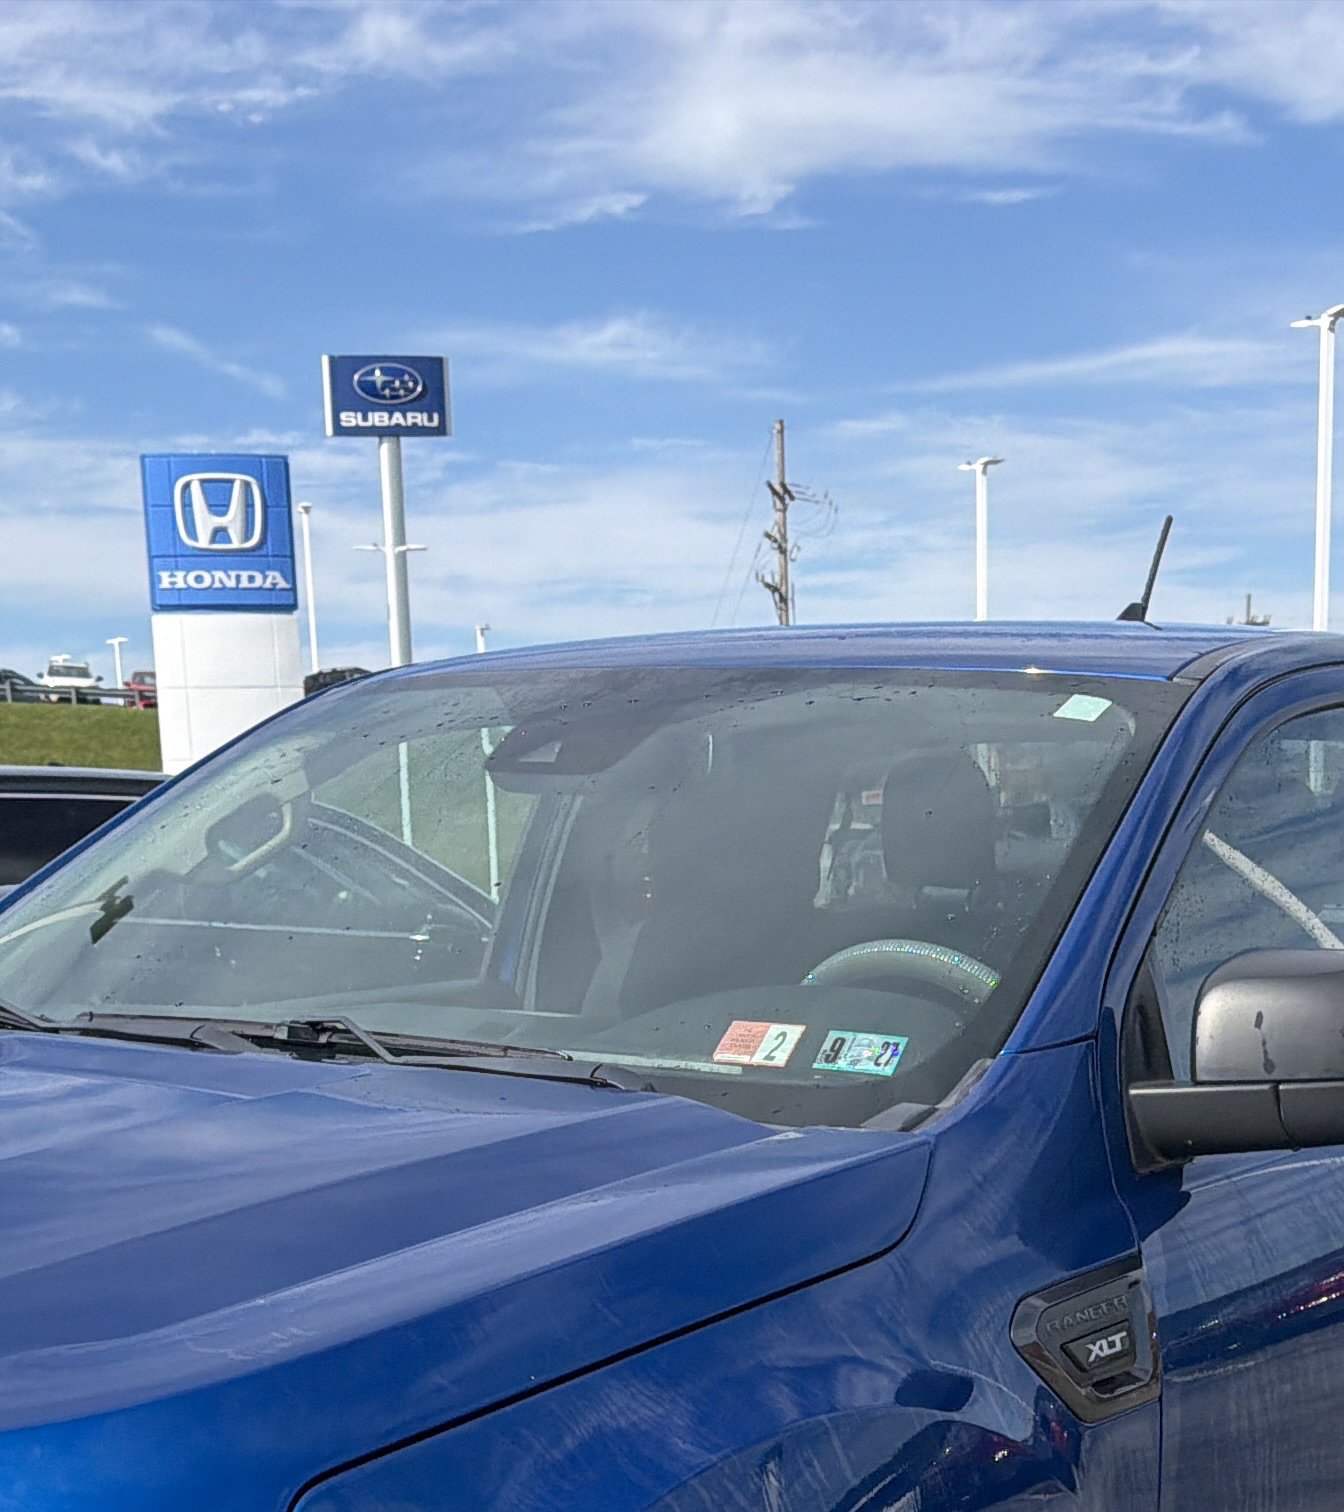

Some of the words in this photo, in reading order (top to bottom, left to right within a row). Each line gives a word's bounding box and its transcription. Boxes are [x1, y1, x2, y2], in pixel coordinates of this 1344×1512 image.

[339, 411, 440, 428] SUBARU
[158, 570, 291, 590] HONDA
[762, 1030, 788, 1062] 2
[825, 1037, 847, 1064] 9
[1046, 1295, 1129, 1334] RANGER
[1085, 1330, 1128, 1362] XLT
